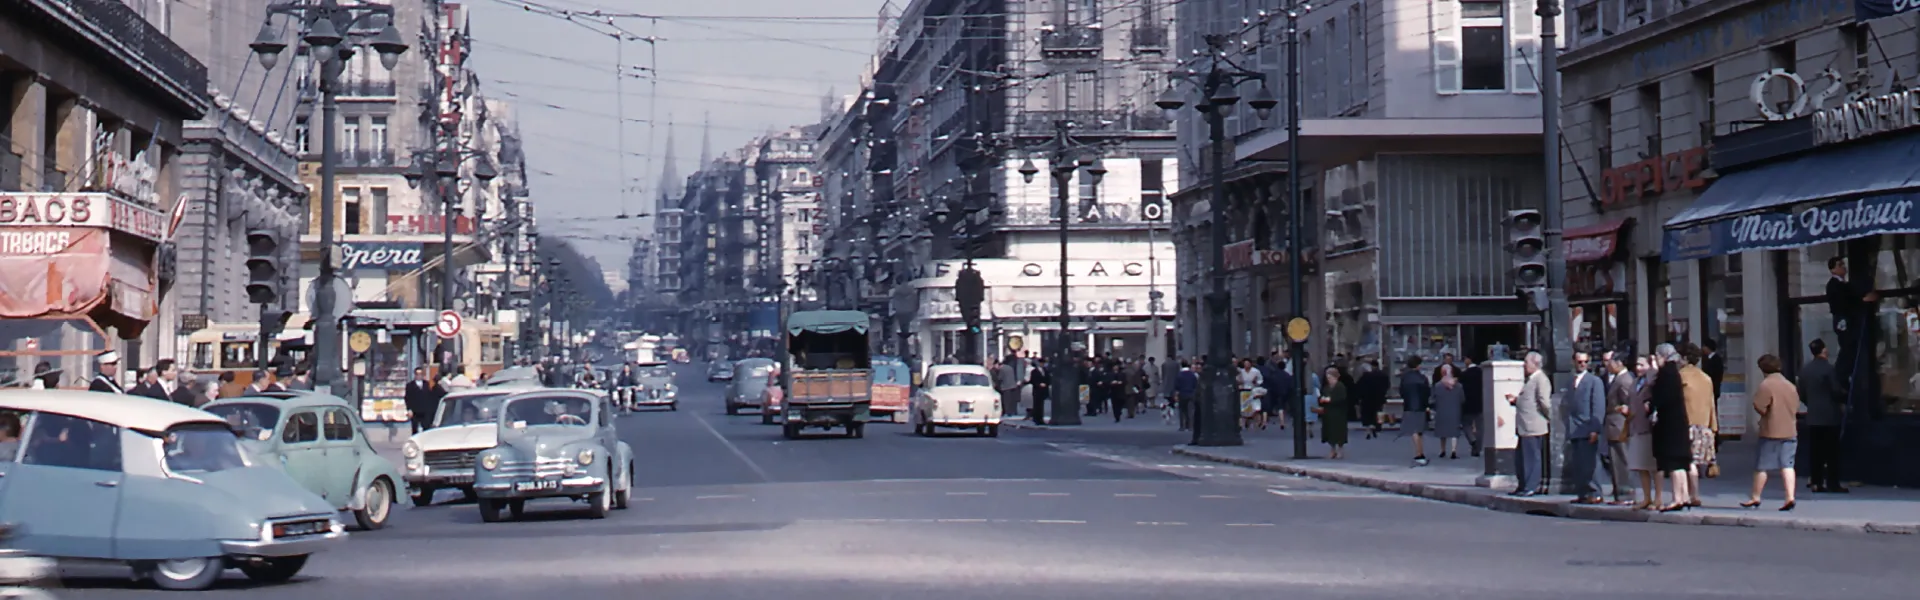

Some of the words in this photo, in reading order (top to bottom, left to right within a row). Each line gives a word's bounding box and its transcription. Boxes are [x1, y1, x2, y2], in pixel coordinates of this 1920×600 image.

[1601, 146, 1706, 206] OFFICE
[1731, 213, 1798, 243] Mont
[1800, 199, 1914, 236] Ventoux
